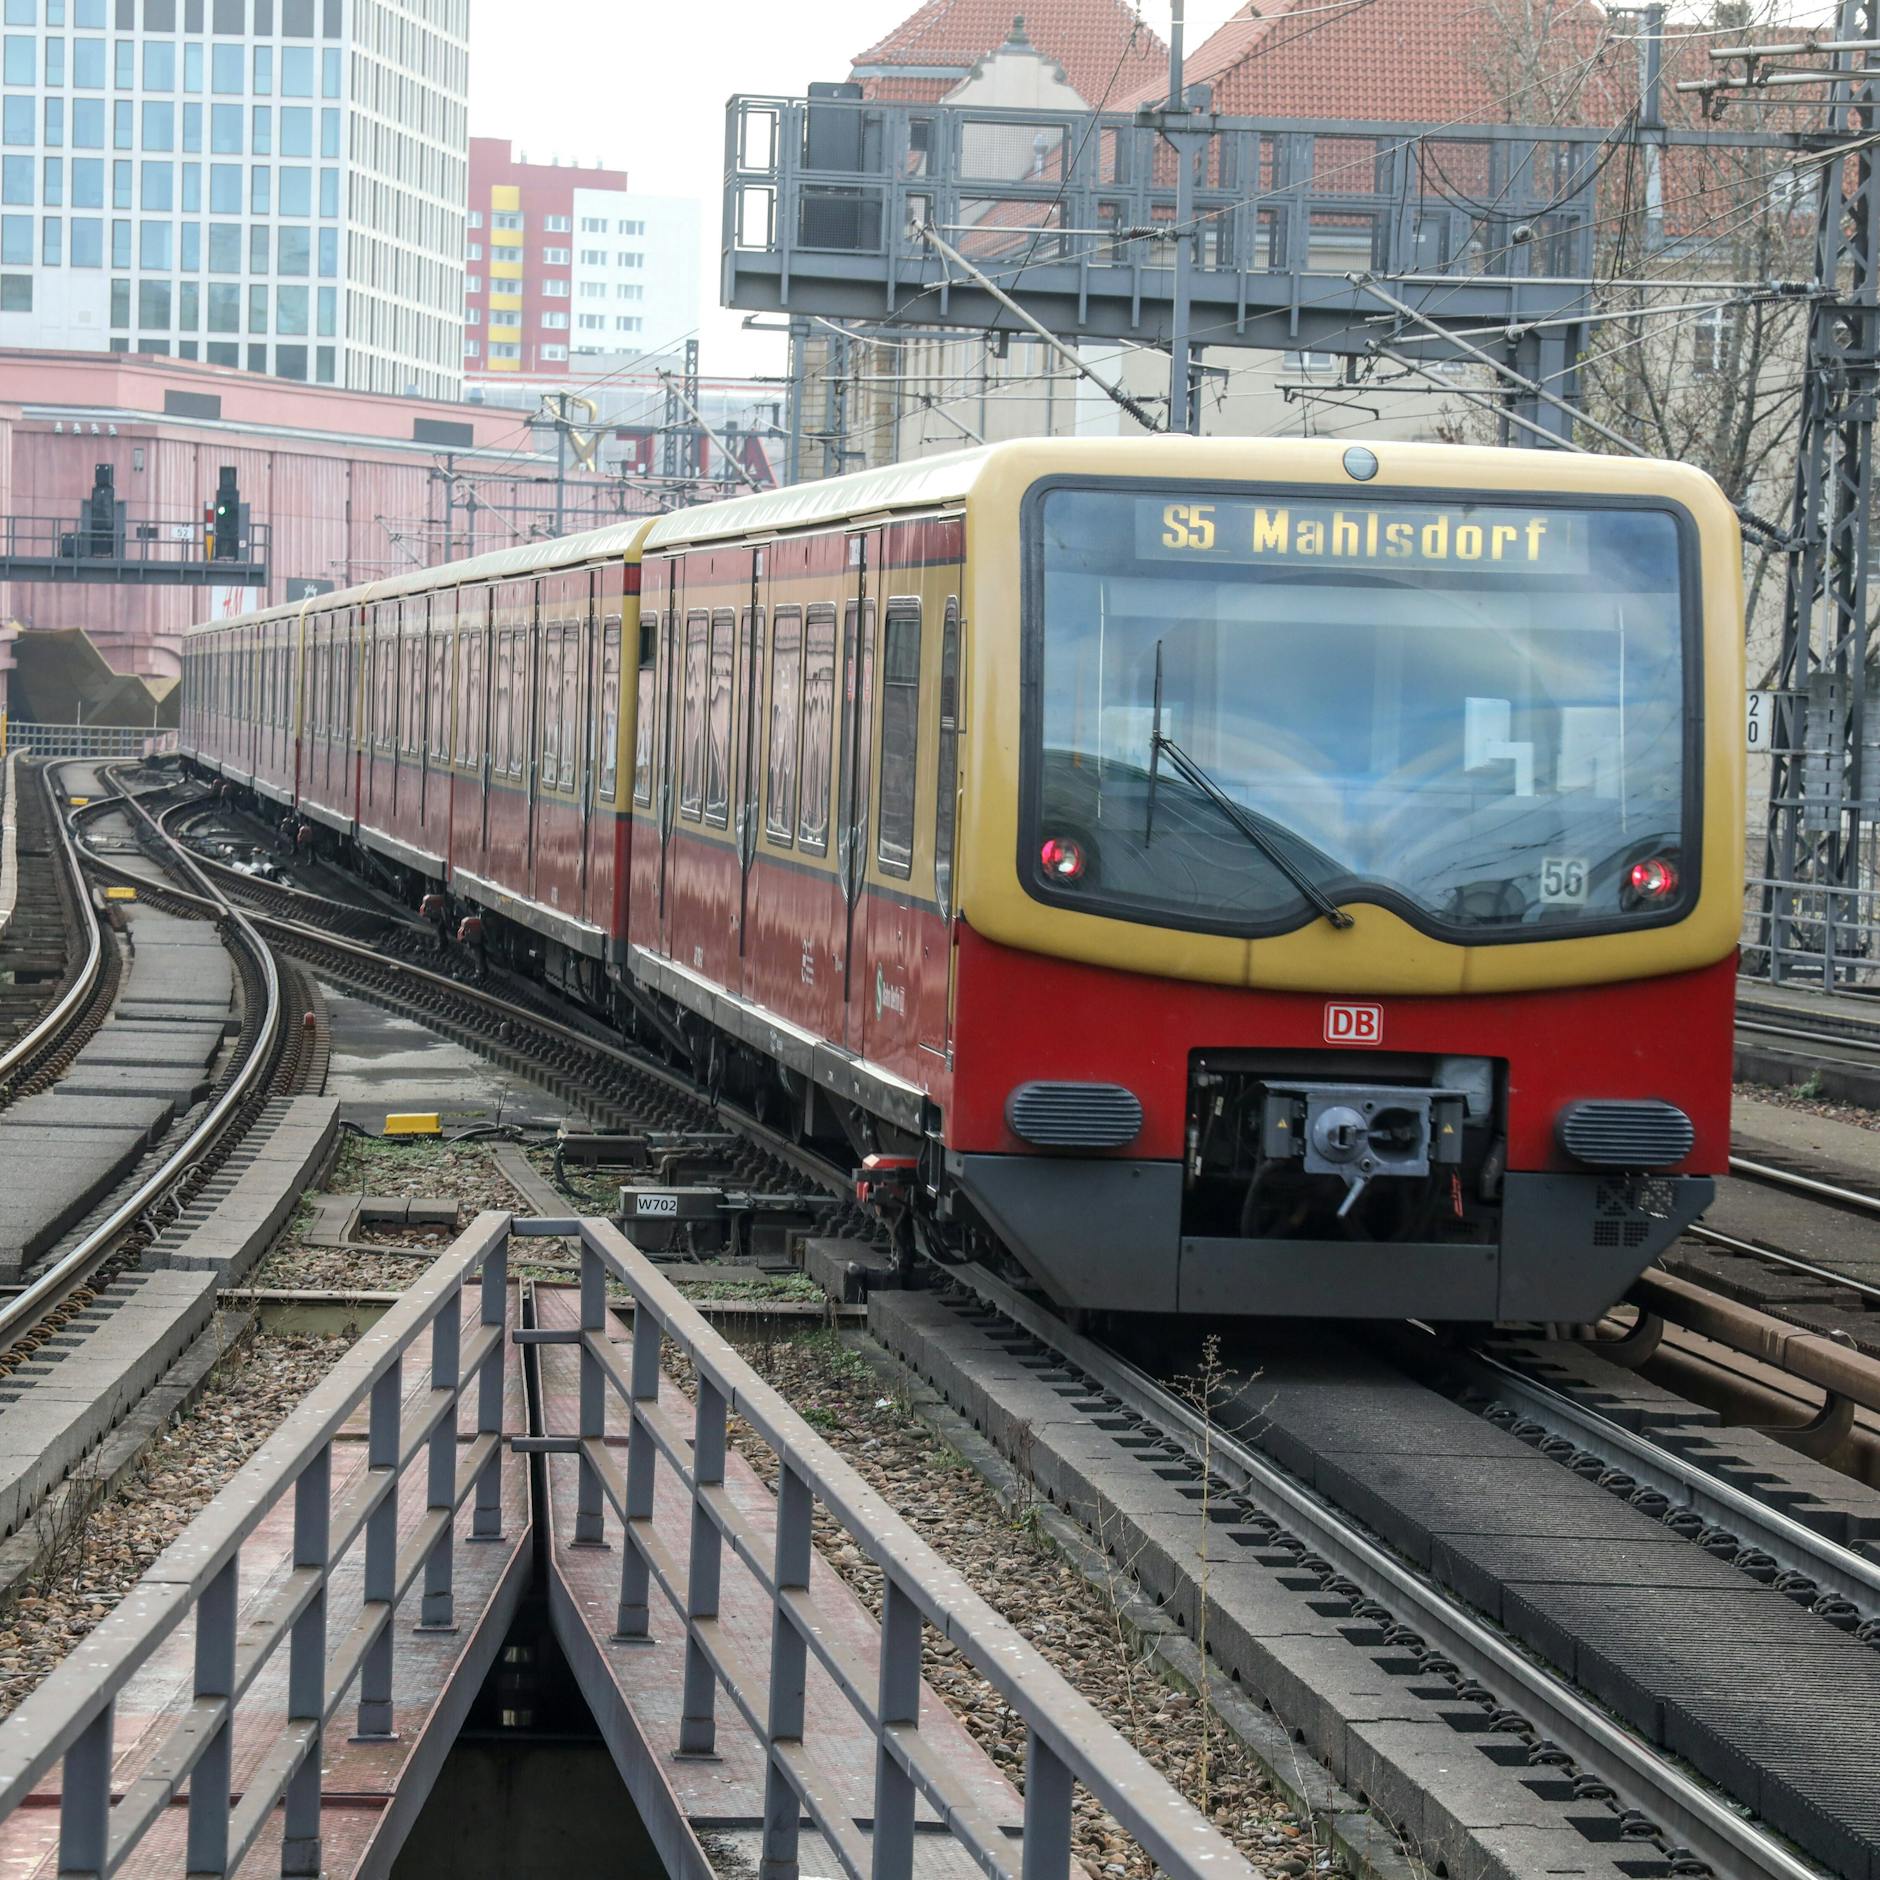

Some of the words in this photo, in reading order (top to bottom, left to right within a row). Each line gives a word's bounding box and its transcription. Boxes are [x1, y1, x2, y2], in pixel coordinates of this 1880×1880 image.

[1162, 504, 1216, 550] S5
[1252, 508, 1549, 561] Mahlsdorf
[1543, 860, 1583, 897] 56
[1332, 1008, 1375, 1037] DB
[638, 1198, 677, 1212] W702
